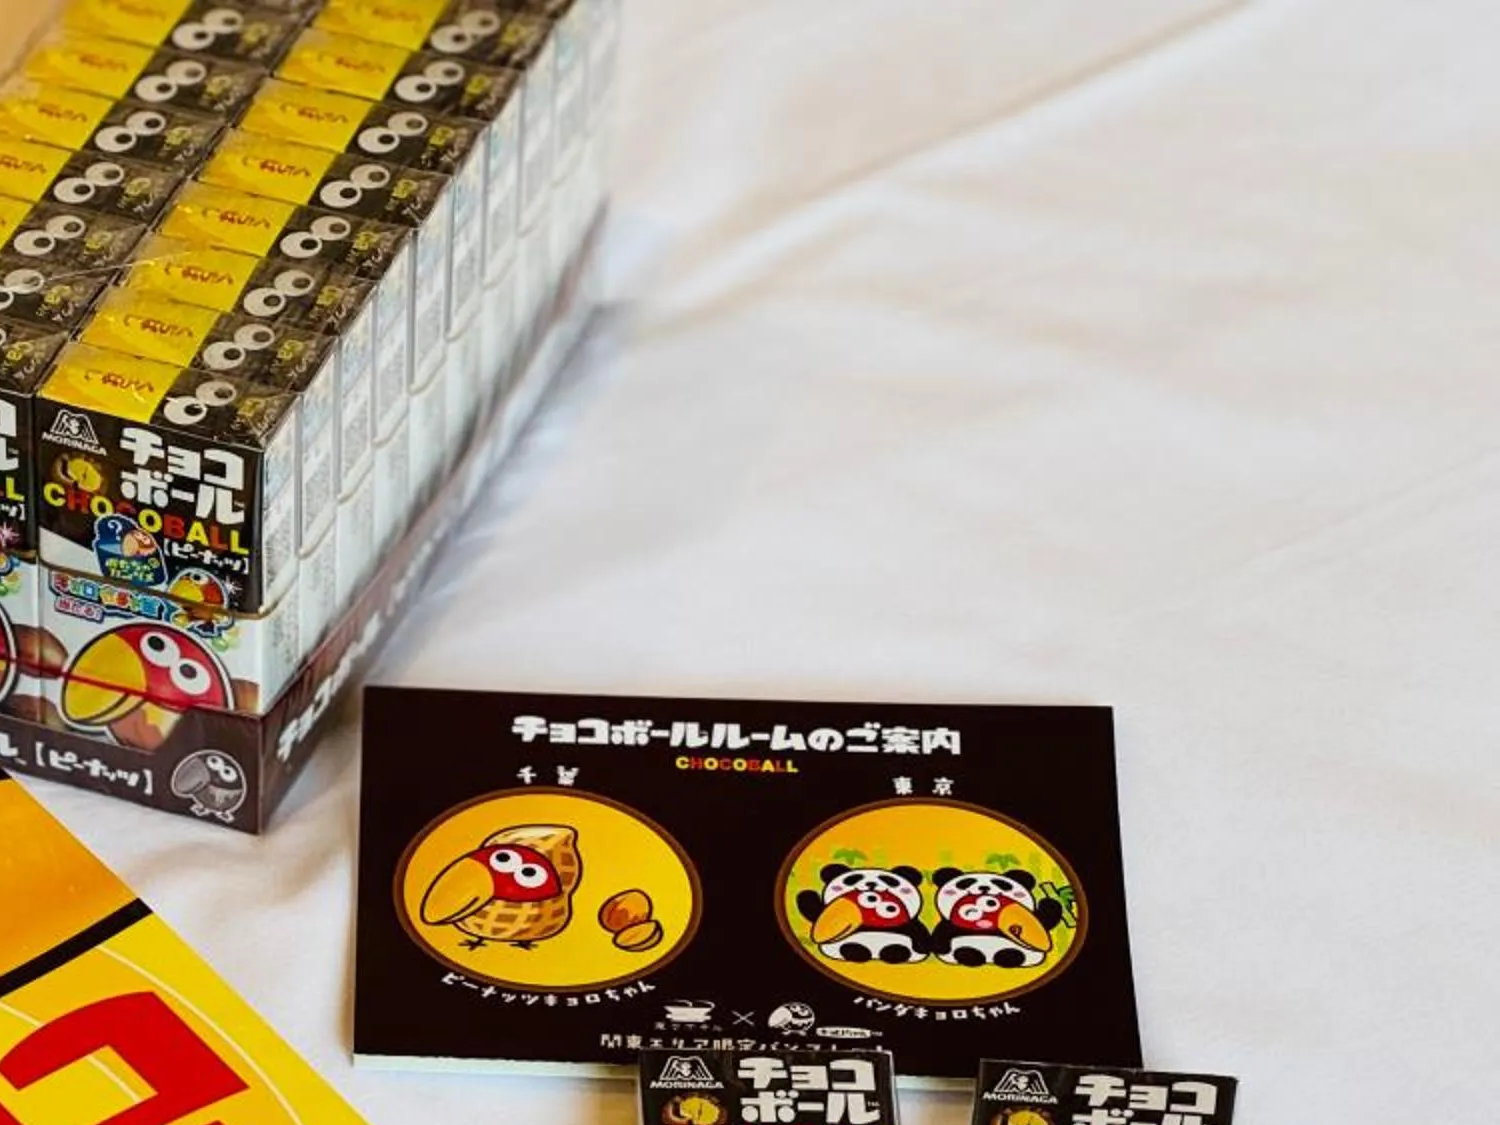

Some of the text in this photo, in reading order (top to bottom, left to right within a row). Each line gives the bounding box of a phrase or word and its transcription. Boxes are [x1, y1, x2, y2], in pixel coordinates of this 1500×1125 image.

[42, 431, 107, 456] MORINAGA
[120, 426, 245, 491] チョコ
[120, 466, 245, 525] ボール
[511, 715, 962, 756] チョコボールルームのご案内
[675, 756, 799, 773] CHOCOBALL
[440, 971, 656, 1007] ピーナッツキョロちゃん
[853, 996, 1021, 1021] パンダキョロちゃん
[650, 1080, 724, 1089] MORINAGA
[737, 1056, 876, 1091] チョコ
[740, 1089, 881, 1125] ボール
[983, 1092, 1058, 1105] MORINAGA
[1075, 1074, 1217, 1115] チョコ
